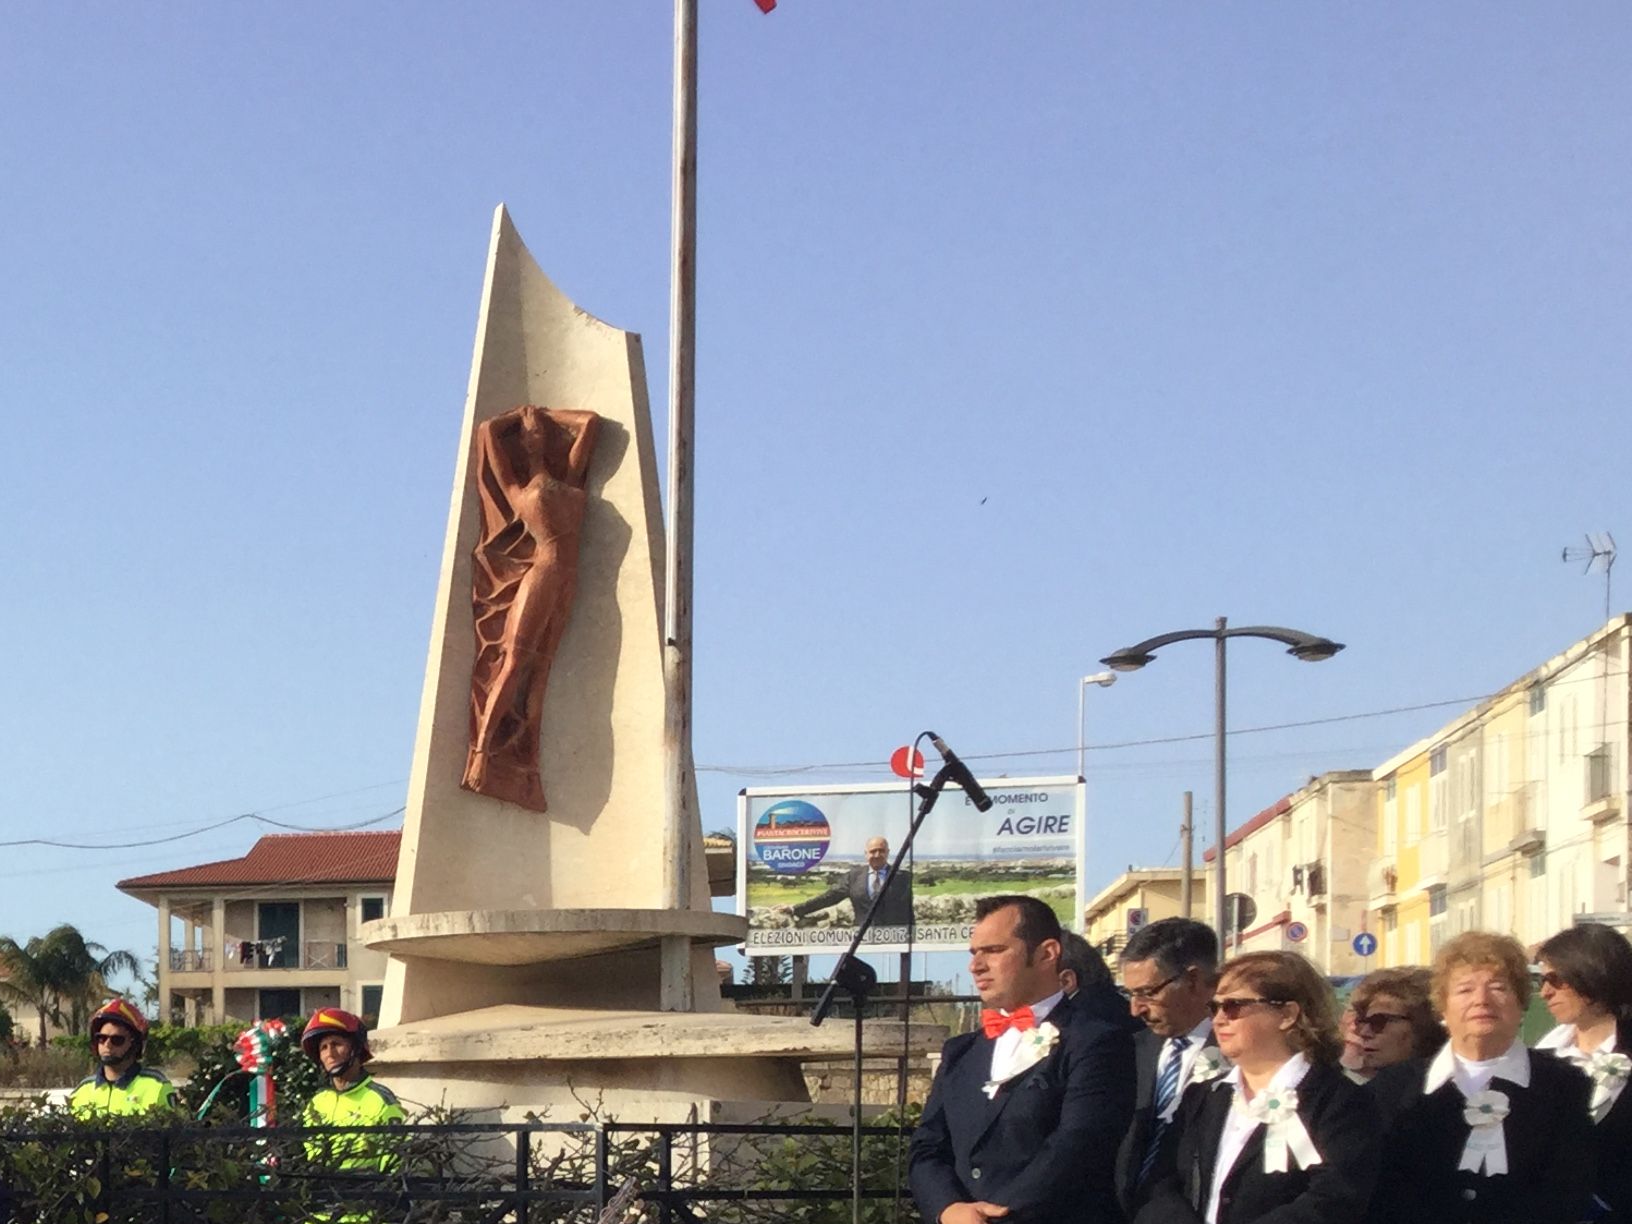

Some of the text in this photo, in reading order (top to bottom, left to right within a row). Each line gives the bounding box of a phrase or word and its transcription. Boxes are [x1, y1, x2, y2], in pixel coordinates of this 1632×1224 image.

[996, 815, 1071, 836] AGIRE
[763, 848, 821, 860] BARONE
[754, 930, 806, 945] ELEZIONI
[875, 927, 907, 943] 2017
[918, 927, 958, 941] SANTA
